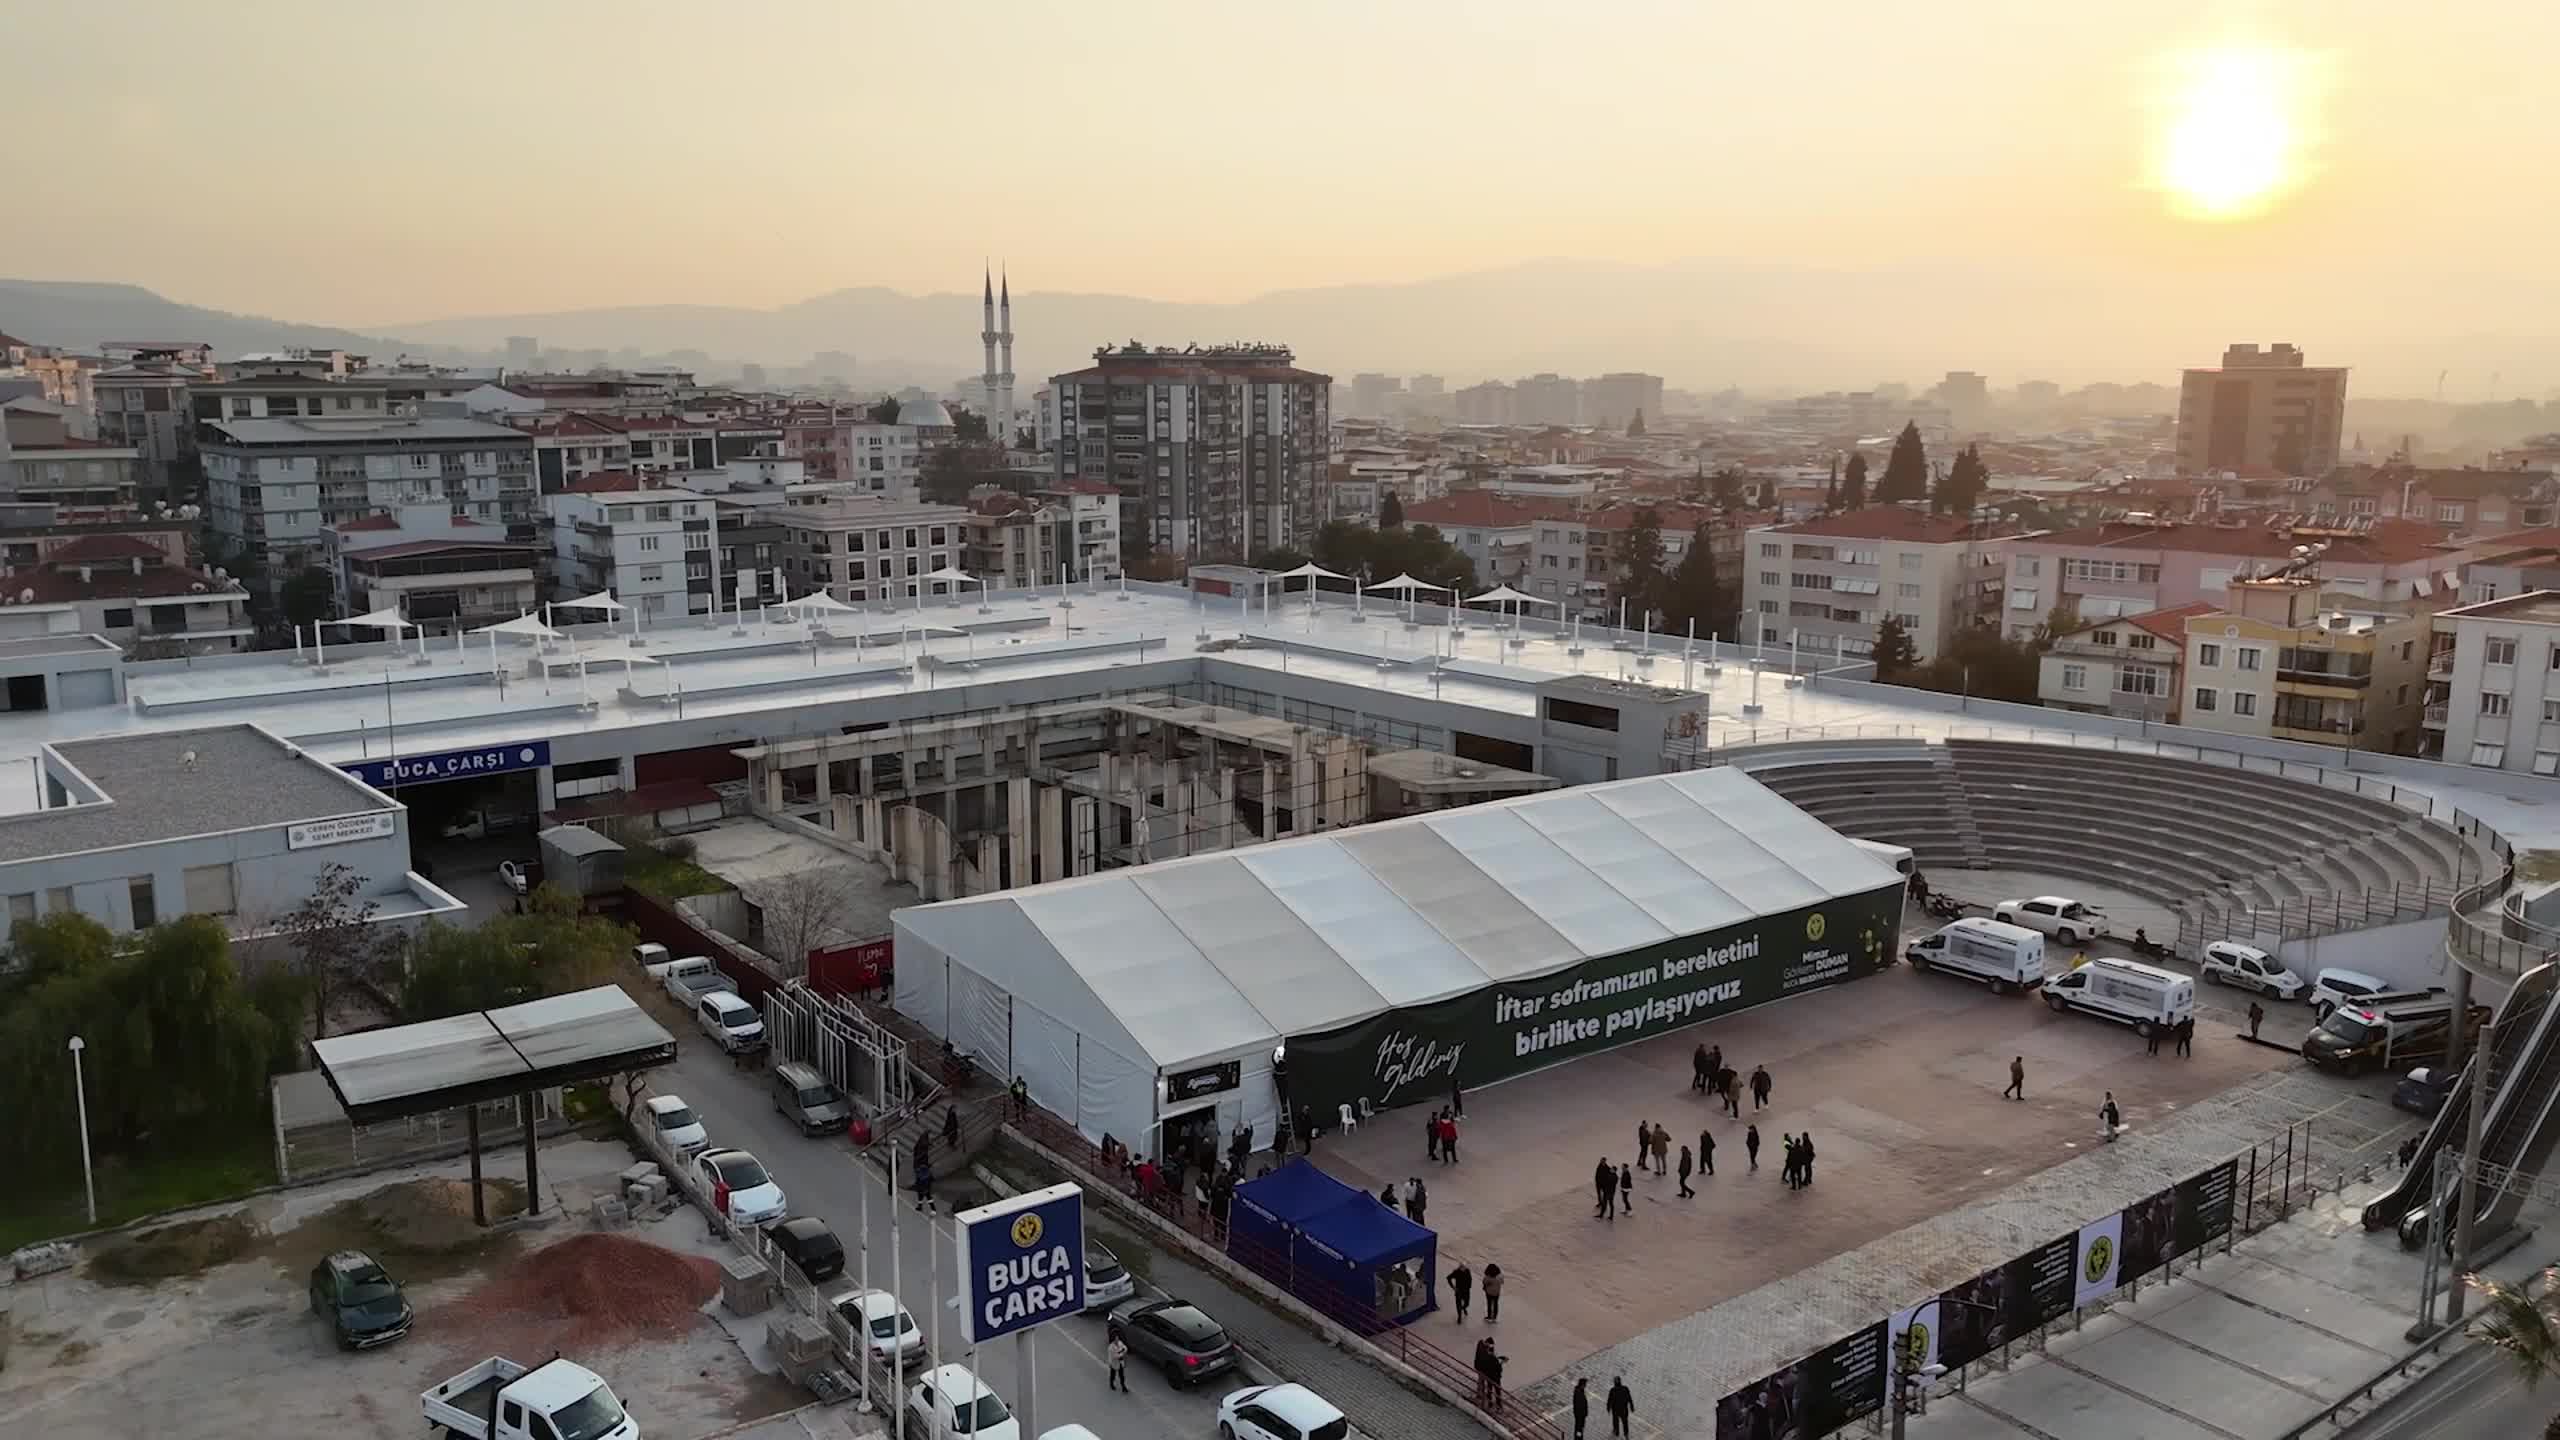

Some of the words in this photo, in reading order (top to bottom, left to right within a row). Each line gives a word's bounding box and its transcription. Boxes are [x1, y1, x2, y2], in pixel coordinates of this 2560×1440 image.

[383, 761, 438, 780] BUCA
[447, 752, 505, 773] ÇARŞI
[1495, 993, 1545, 1024] İftar
[1550, 966, 1658, 1010] soframızın
[1663, 934, 1760, 980] bereketini
[1515, 1015, 1600, 1056] birlikte
[1605, 979, 1742, 1037] paylaşıyoruz
[987, 1245, 1071, 1293] BUCA
[984, 1274, 1074, 1329] ÇARŞI
